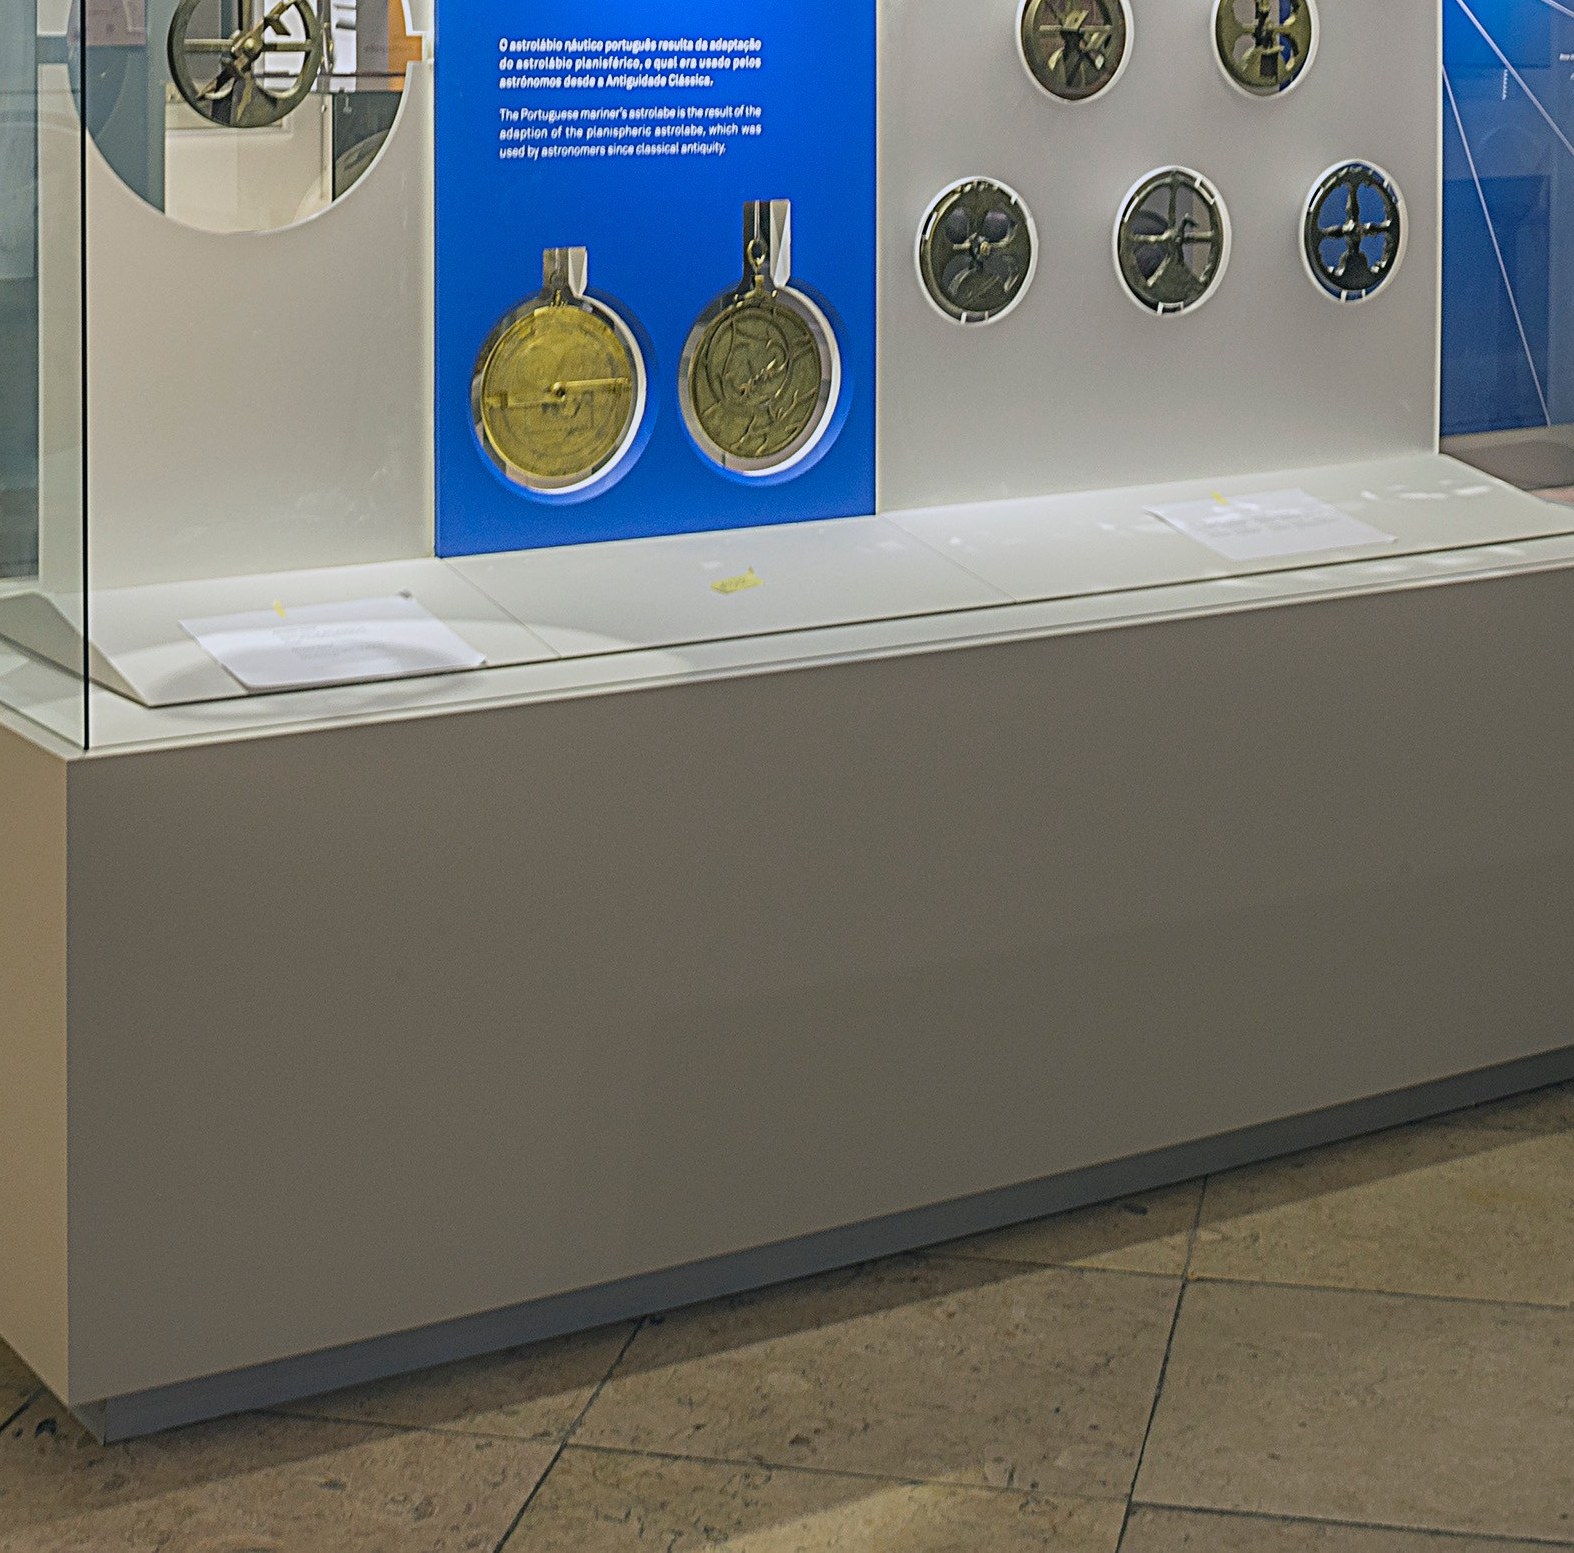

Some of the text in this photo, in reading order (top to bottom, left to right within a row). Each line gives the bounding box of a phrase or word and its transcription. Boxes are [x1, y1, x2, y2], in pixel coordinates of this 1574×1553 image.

[499, 38, 761, 53] O astrolábio náutico português resulta da adaptação
[499, 57, 513, 69] do
[516, 57, 572, 69] astrolábio
[644, 58, 651, 68] o
[653, 56, 677, 69] qual
[679, 58, 696, 68] era
[699, 56, 730, 68] usado
[733, 56, 761, 69] pelos
[499, 76, 561, 87] astrónomos
[563, 75, 595, 87] desde
[597, 76, 603, 87] a
[605, 74, 666, 88] Antiguidade
[500, 105, 761, 121] The Portuguese mariner's astrolabe is the result of the
[499, 128, 547, 139] adaption
[551, 125, 561, 138] of
[565, 127, 583, 137] the
[709, 124, 737, 134] which
[741, 124, 761, 134] was
[499, 146, 524, 157] used
[527, 145, 539, 159] by
[541, 146, 605, 156] astronomers
[607, 145, 633, 155] since
[635, 143, 678, 154] classical
